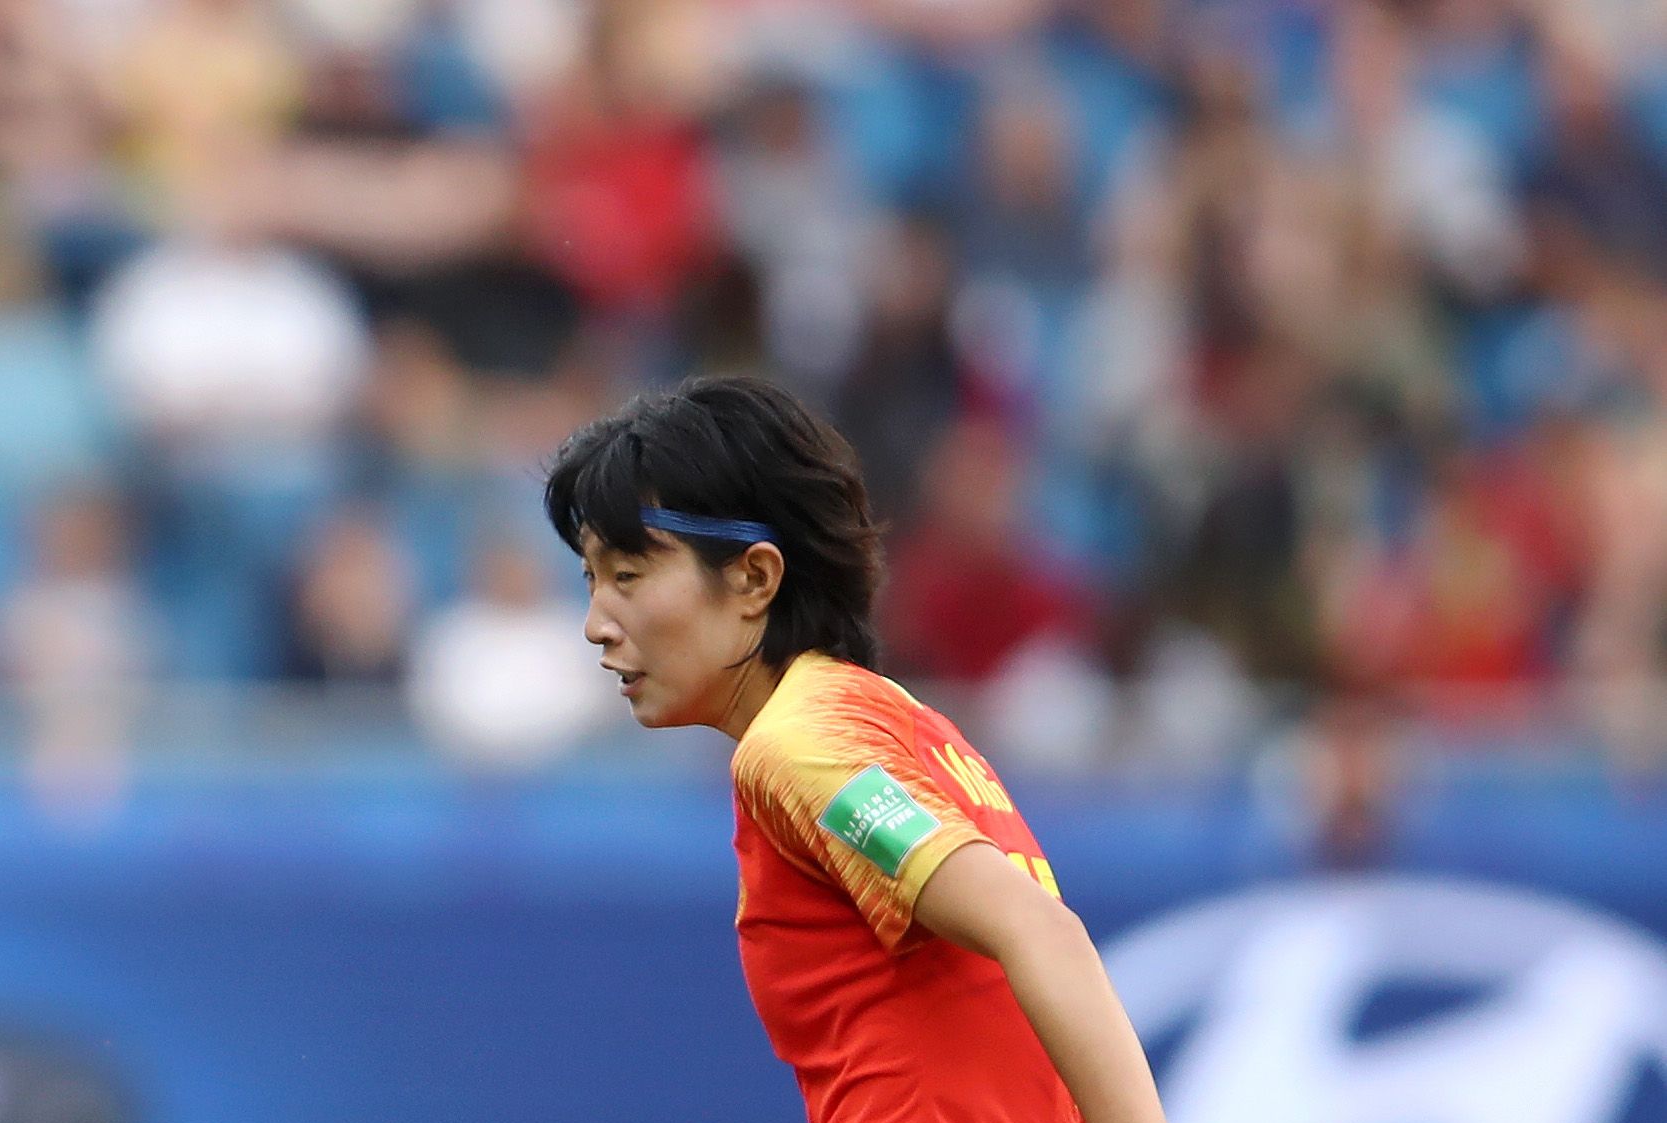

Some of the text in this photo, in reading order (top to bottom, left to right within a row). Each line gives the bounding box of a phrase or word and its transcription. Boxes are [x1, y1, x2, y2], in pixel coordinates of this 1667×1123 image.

[843, 784, 895, 838] LIVING
[852, 794, 901, 845] FOOTBALL
[885, 806, 916, 831] FIFA
